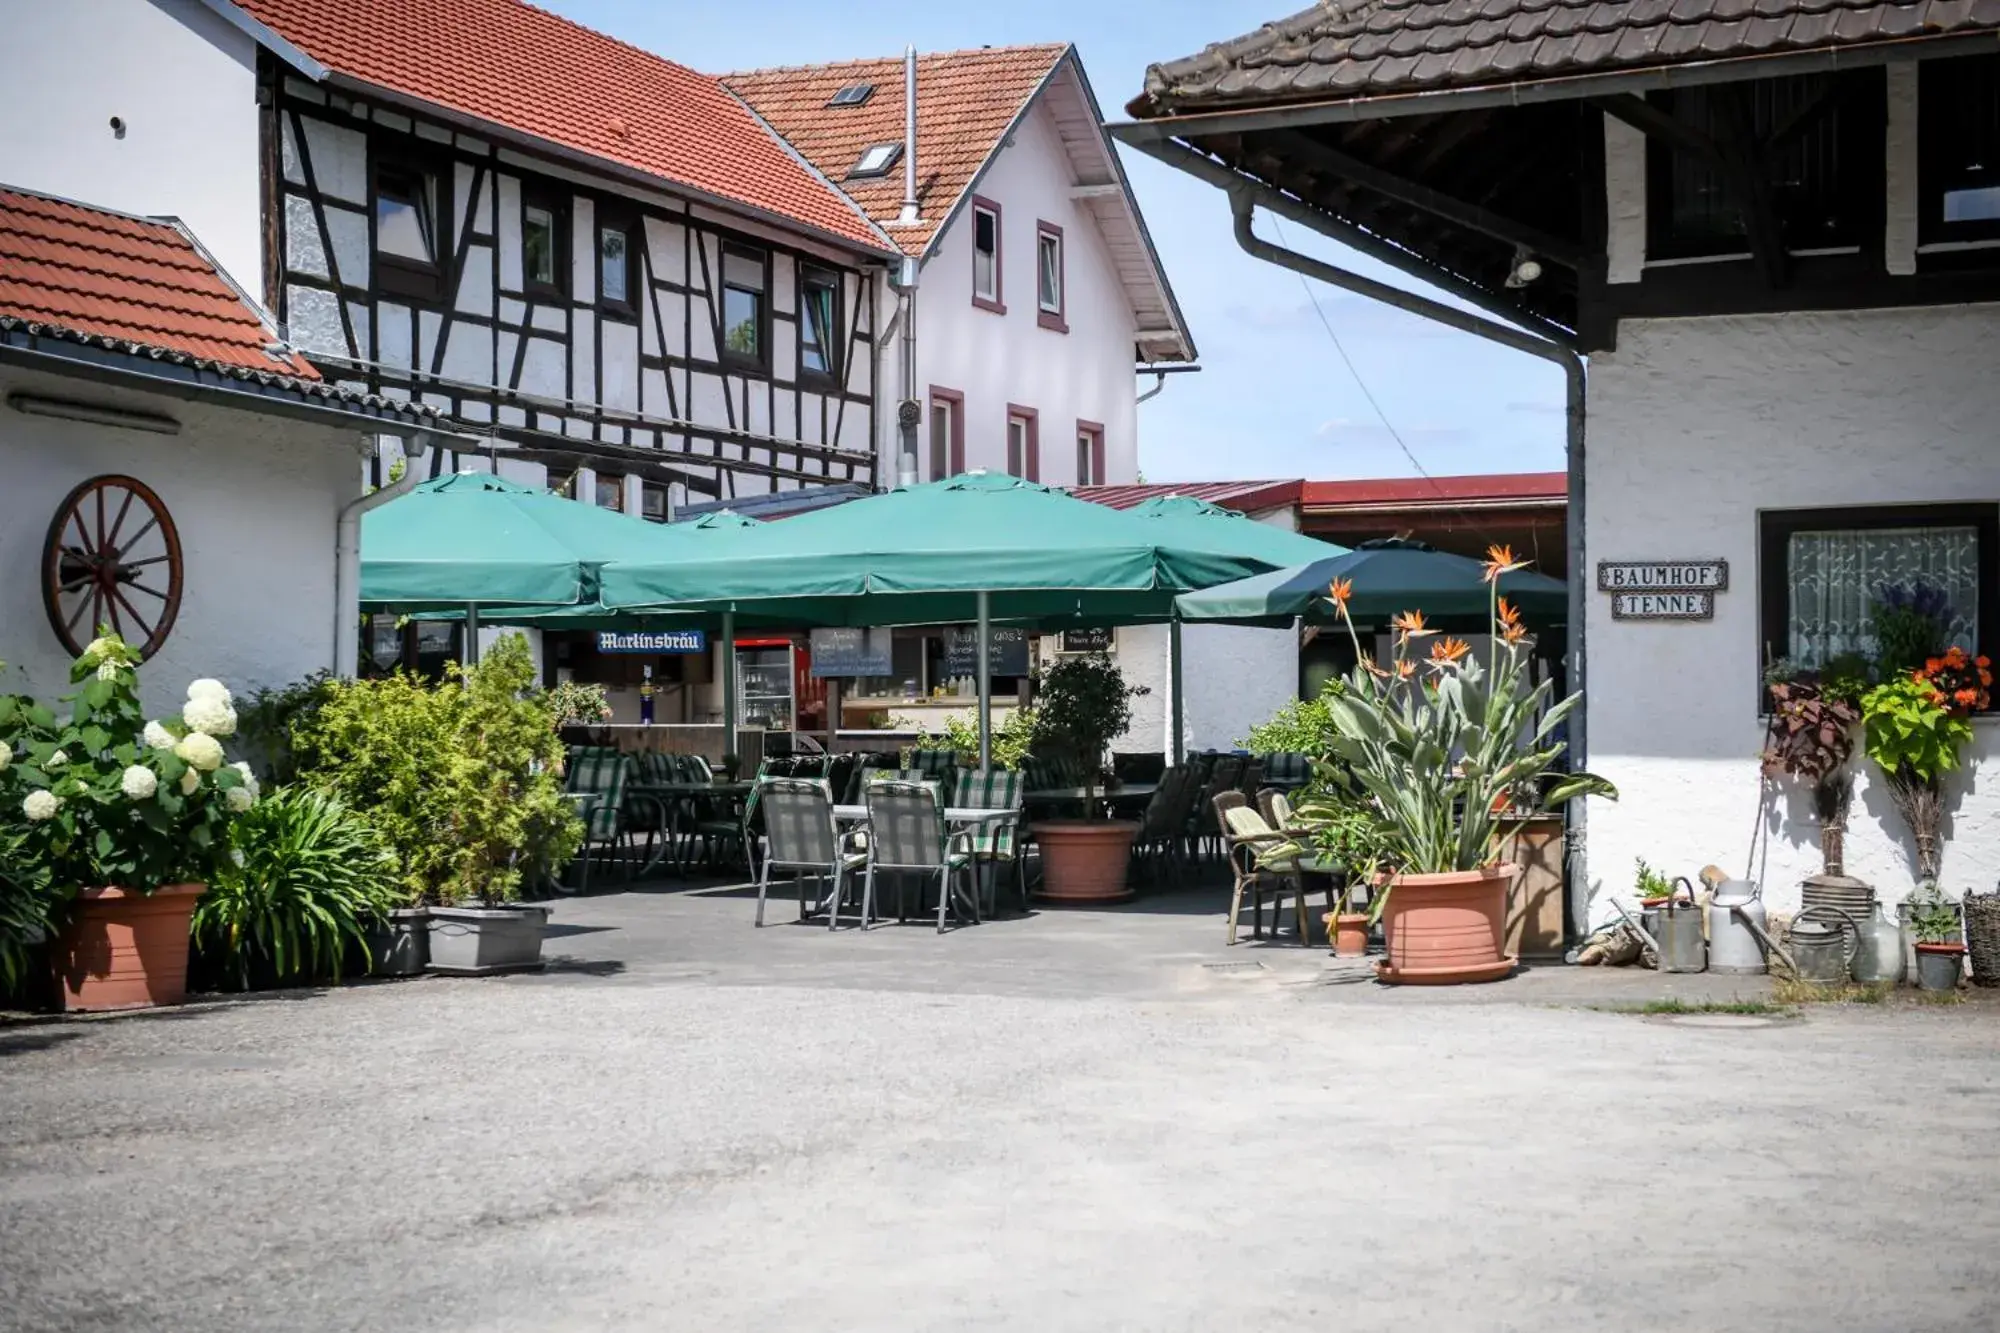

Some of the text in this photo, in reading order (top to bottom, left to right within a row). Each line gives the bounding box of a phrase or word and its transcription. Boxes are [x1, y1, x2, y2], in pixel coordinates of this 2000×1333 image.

[1613, 567, 1711, 585] BAUMHOF
[1627, 595, 1697, 613] TENNE
[600, 632, 699, 649] Martinsbräu
